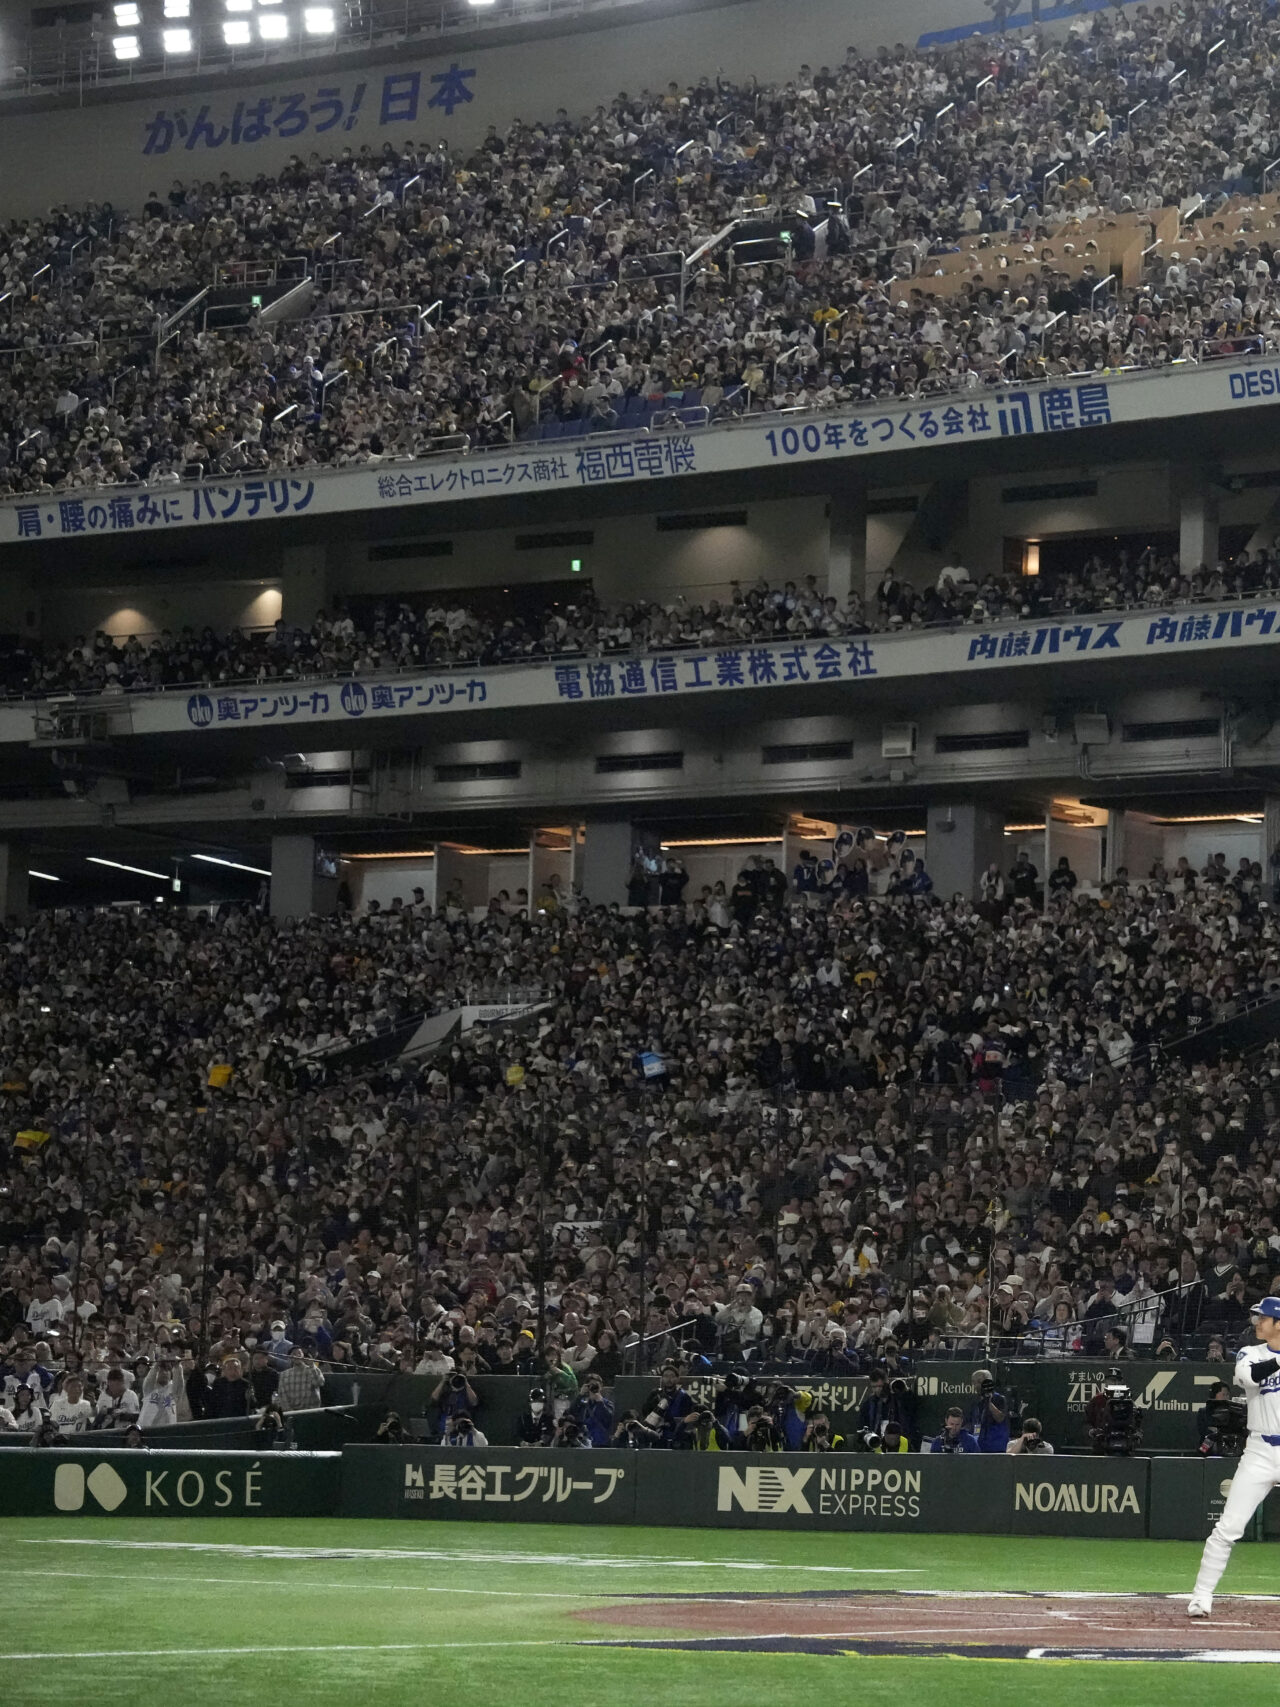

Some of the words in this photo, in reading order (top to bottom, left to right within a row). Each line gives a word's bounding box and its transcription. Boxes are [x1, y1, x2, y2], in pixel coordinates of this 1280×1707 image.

[379, 63, 477, 126] 日本
[765, 404, 991, 457] 100年をつくる会社
[1040, 384, 1112, 432] 鹿島
[377, 457, 569, 499] 総合エレクトロニクス商社
[575, 436, 697, 484] 福西電機
[14, 495, 183, 537] 肩・腰の痛みに
[193, 480, 315, 520] バンテリン
[967, 621, 1124, 661] 内藤ハウス
[555, 640, 878, 700] 電協通信工業株式会社
[217, 691, 329, 721] 奥アンツーカ
[371, 679, 487, 709] 奥アンツーカ
[1069, 1371, 1105, 1382] すまいの
[1155, 1400, 1189, 1411] Uniho
[145, 1461, 263, 1507] KOSÉ
[429, 1464, 625, 1504] 長谷工グループ
[820, 1468, 921, 1493] NIPPON
[1015, 1482, 1141, 1514] NOMURA
[819, 1494, 921, 1518] EXPRESS
